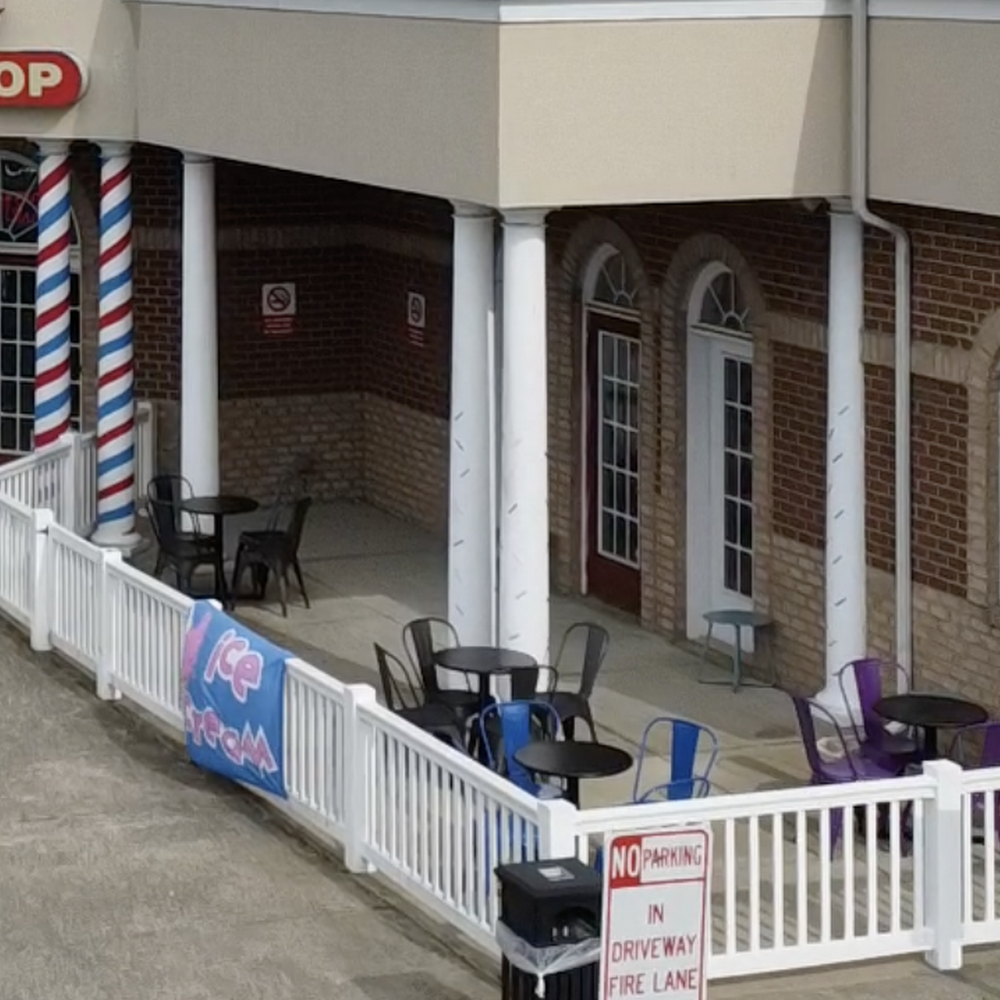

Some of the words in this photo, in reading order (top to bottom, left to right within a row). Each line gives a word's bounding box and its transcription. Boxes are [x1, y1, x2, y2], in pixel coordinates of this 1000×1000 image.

[612, 843, 641, 879] NO
[643, 845, 702, 870] PARKING
[647, 904, 664, 925] IN
[612, 934, 698, 963] DRIVEWAY
[609, 974, 647, 997] FIRE
[653, 969, 698, 993] LANE
